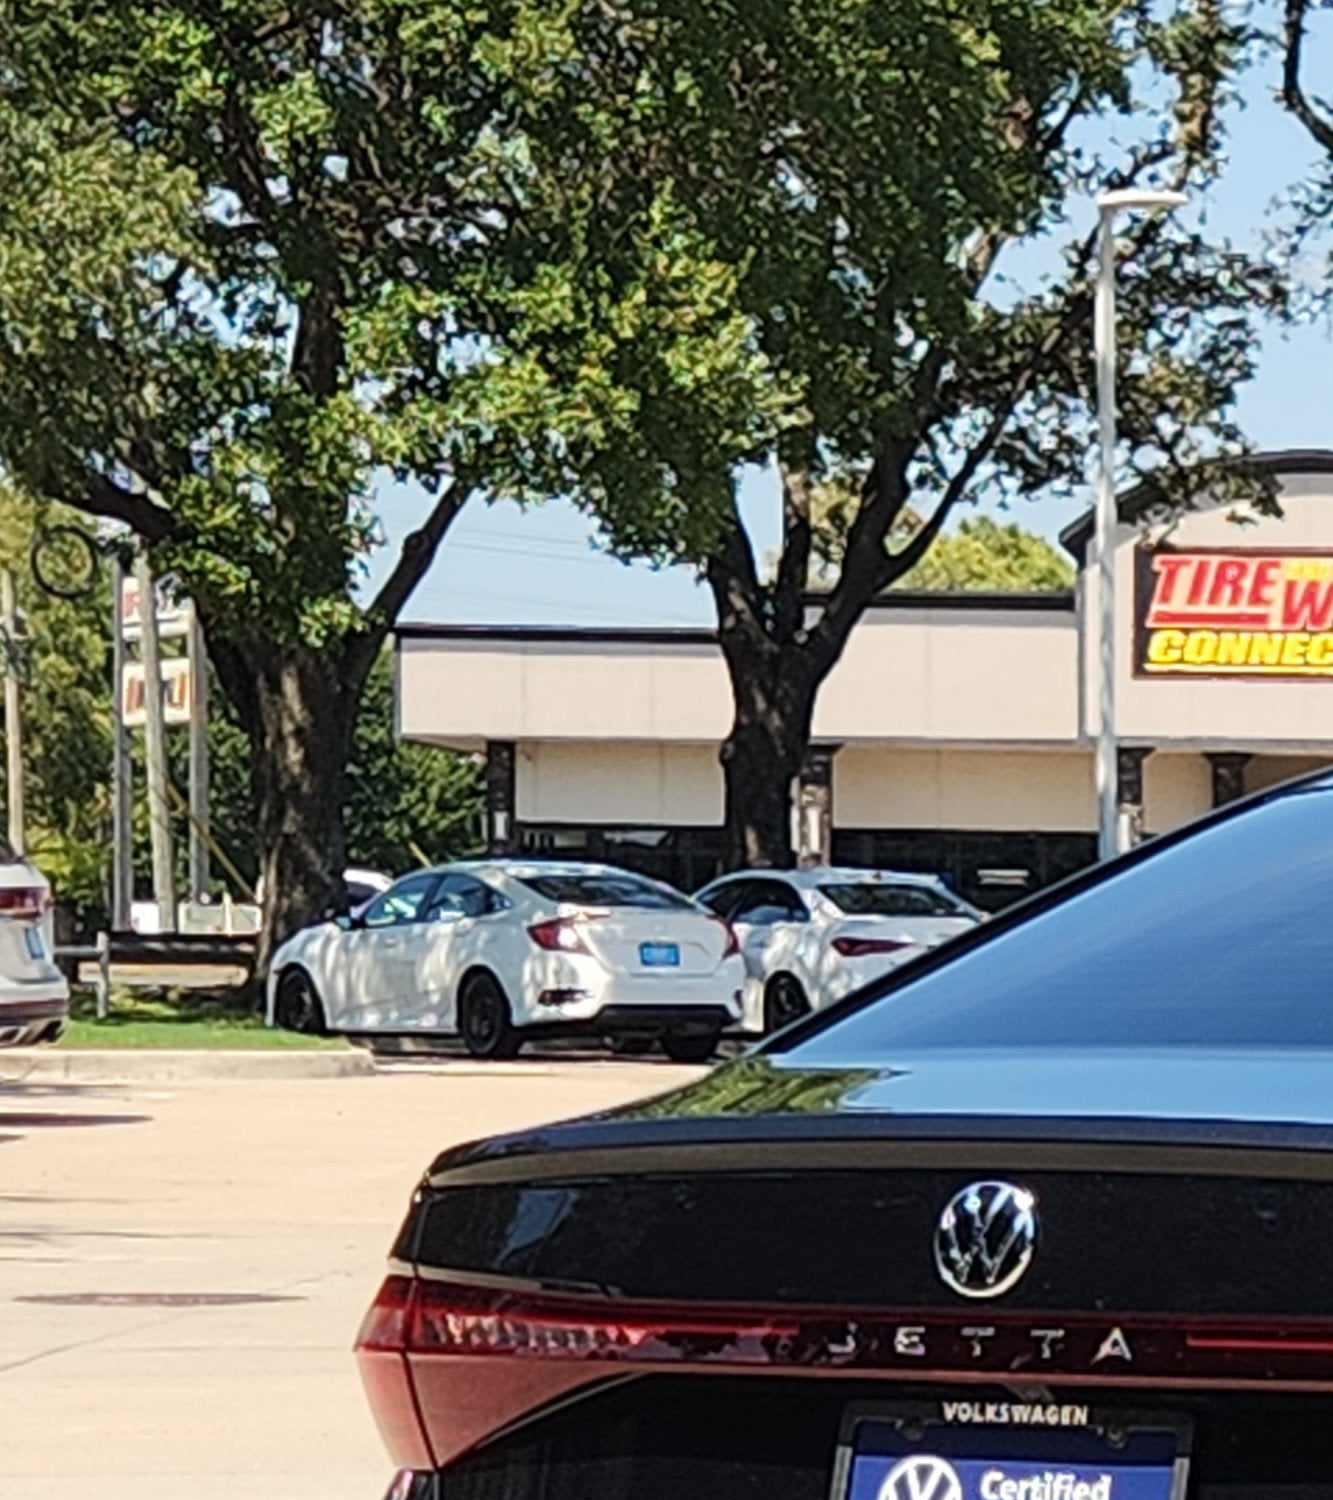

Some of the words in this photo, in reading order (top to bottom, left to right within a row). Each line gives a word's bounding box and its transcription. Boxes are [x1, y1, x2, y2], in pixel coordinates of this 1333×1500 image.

[1156, 559, 1281, 606] TIRE
[827, 1322, 1132, 1363] JETTA
[942, 1401, 1089, 1426] VOLKSWAGEN
